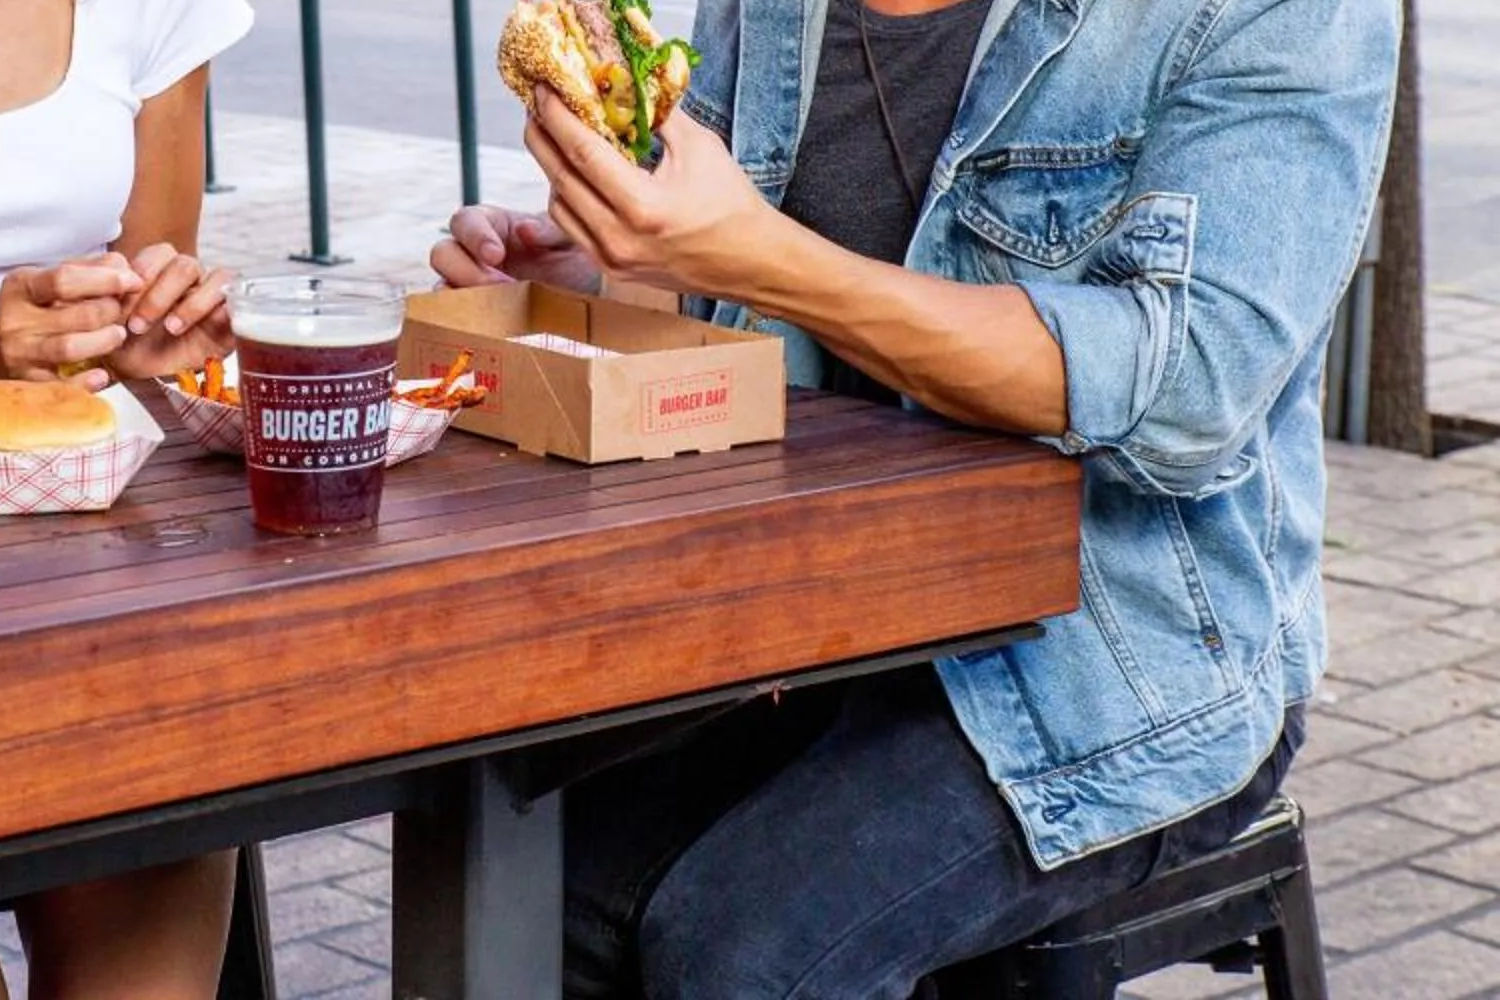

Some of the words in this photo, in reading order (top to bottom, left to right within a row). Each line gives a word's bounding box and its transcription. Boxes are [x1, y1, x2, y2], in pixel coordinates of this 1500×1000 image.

[287, 380, 374, 394] ORIGINAL
[659, 391, 703, 416] BURGER
[706, 387, 728, 407] BAR
[261, 408, 359, 442] BURGER
